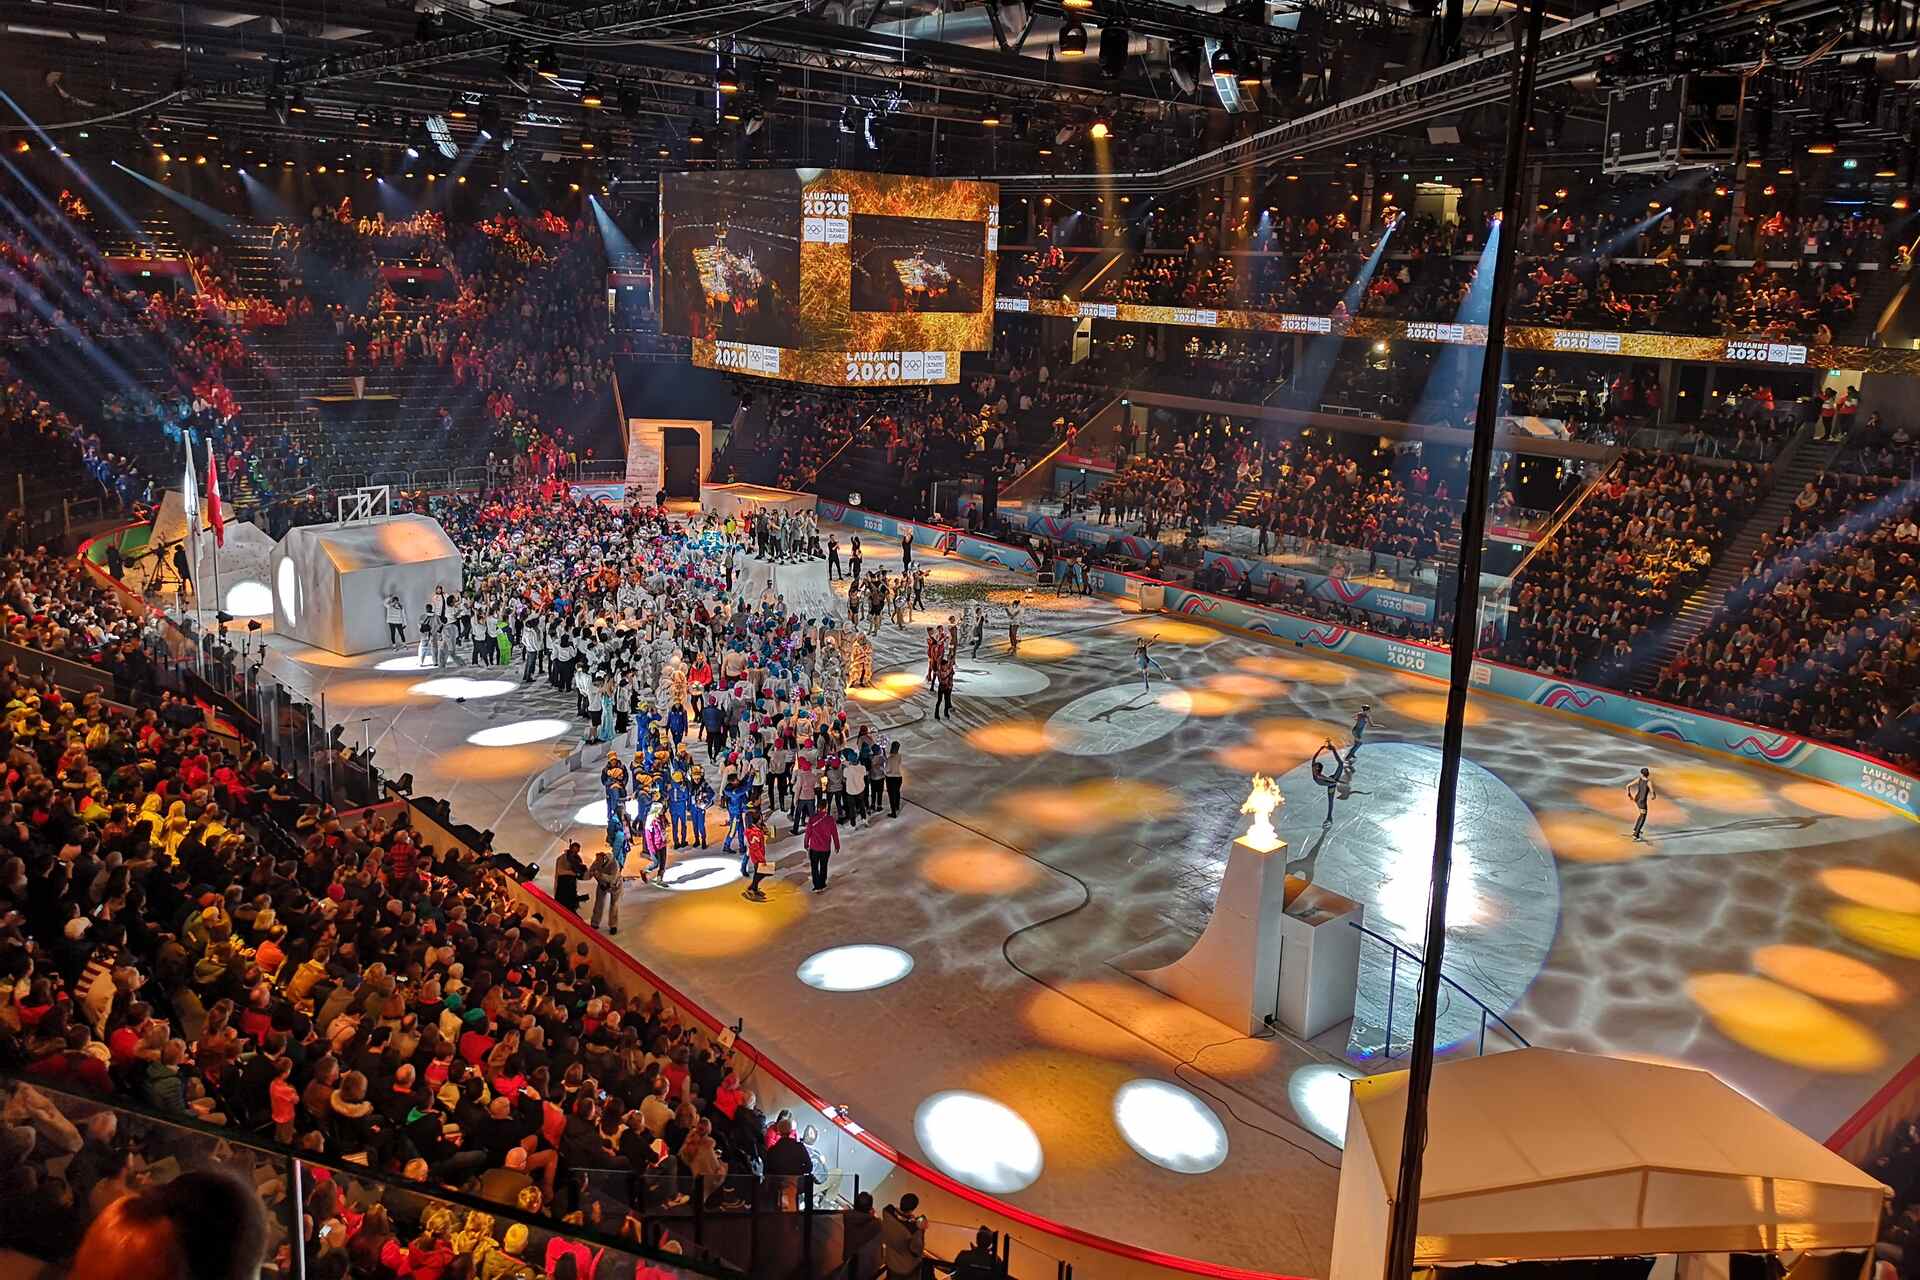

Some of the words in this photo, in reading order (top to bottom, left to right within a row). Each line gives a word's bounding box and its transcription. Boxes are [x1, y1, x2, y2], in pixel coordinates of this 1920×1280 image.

[804, 192, 849, 201] LAUSANNE
[803, 200, 849, 216] 2020
[1280, 320, 1308, 331] 2020
[1407, 329, 1437, 339] 2020
[1553, 336, 1588, 349] 2020
[1727, 341, 1768, 350] LAUSANNE
[715, 347, 747, 369] 2020
[846, 351, 901, 361] LAUSANNE
[1726, 347, 1768, 361] 2020
[846, 362, 901, 381] 2020
[1376, 599, 1402, 611] 2020
[1387, 652, 1425, 670] 2020
[1863, 765, 1912, 790] LAUSANNE
[1860, 774, 1910, 804] 2020
